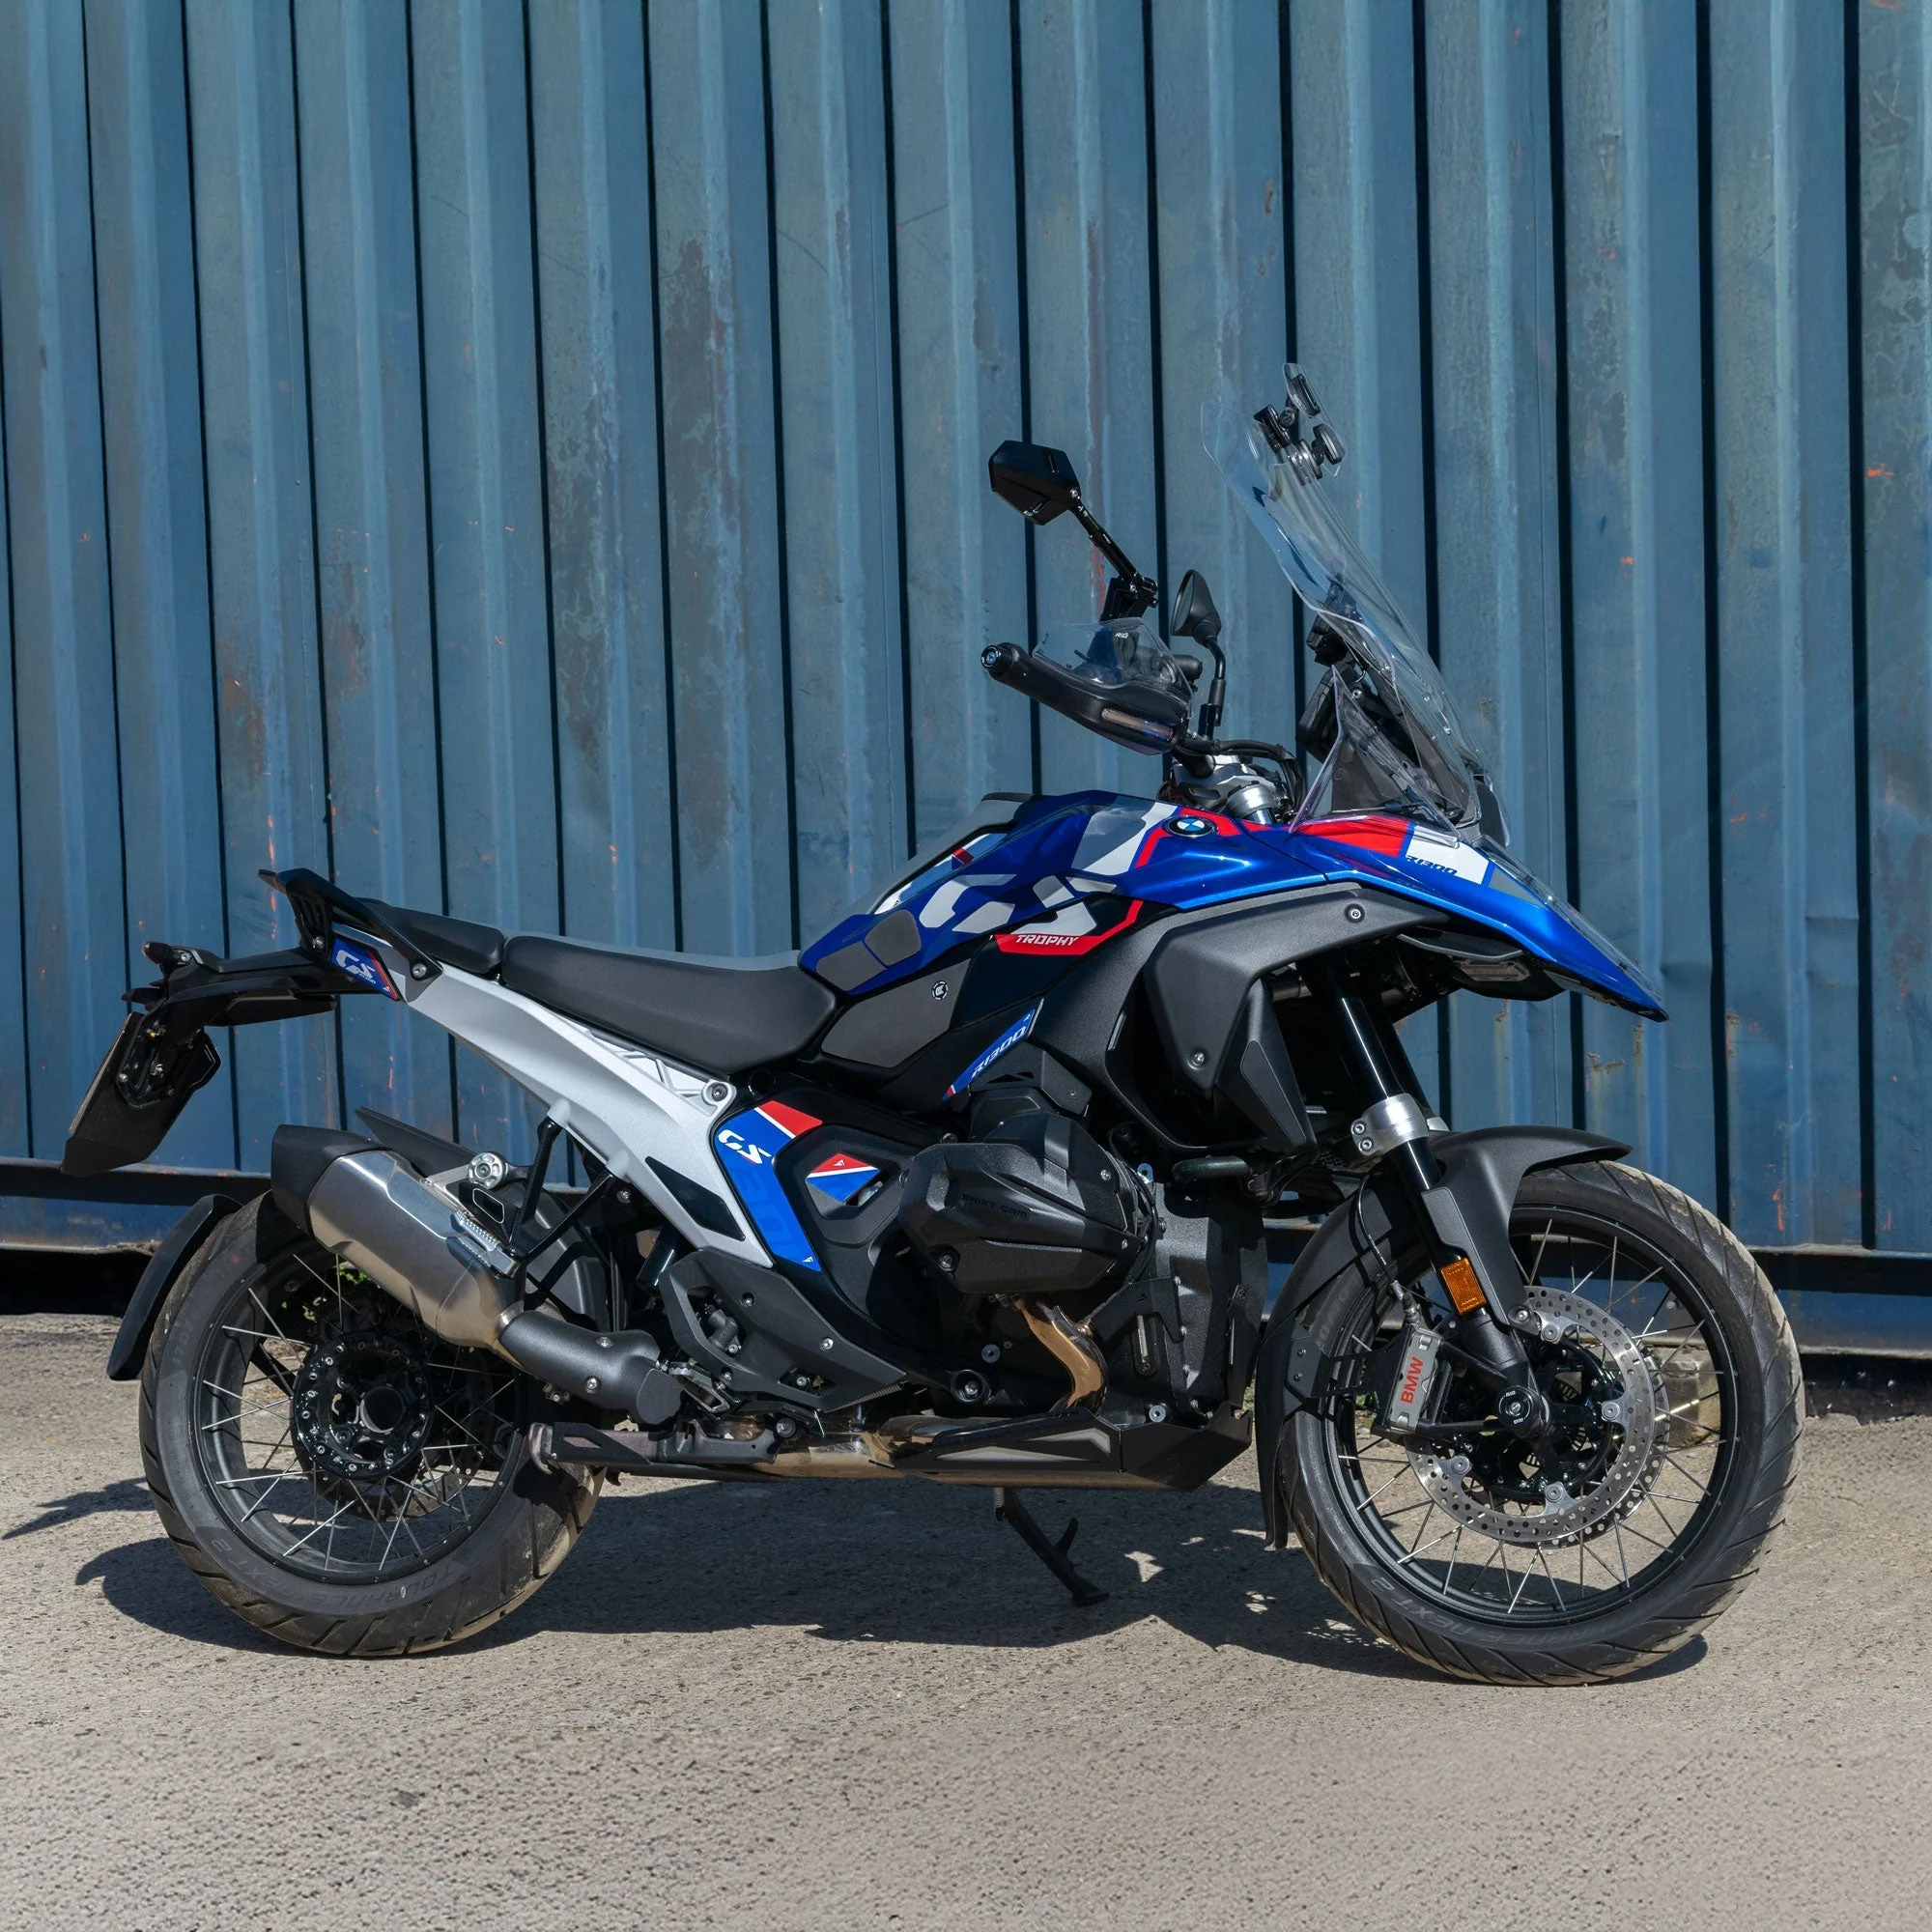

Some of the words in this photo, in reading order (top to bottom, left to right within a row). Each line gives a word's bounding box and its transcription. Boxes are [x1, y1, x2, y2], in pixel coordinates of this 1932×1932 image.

[1406, 854, 1458, 875] R1300
[1015, 934, 1080, 946] TROPHY
[336, 950, 376, 979] GS
[971, 1026, 1027, 1079] R1300
[718, 1129, 772, 1165] GS
[961, 1193, 997, 1208] SHIFT
[999, 1205, 1028, 1218] CAM
[1400, 1356, 1424, 1405] BMW
[1371, 1577, 1395, 1592] 2
[1391, 1598, 1476, 1635] NEXT
